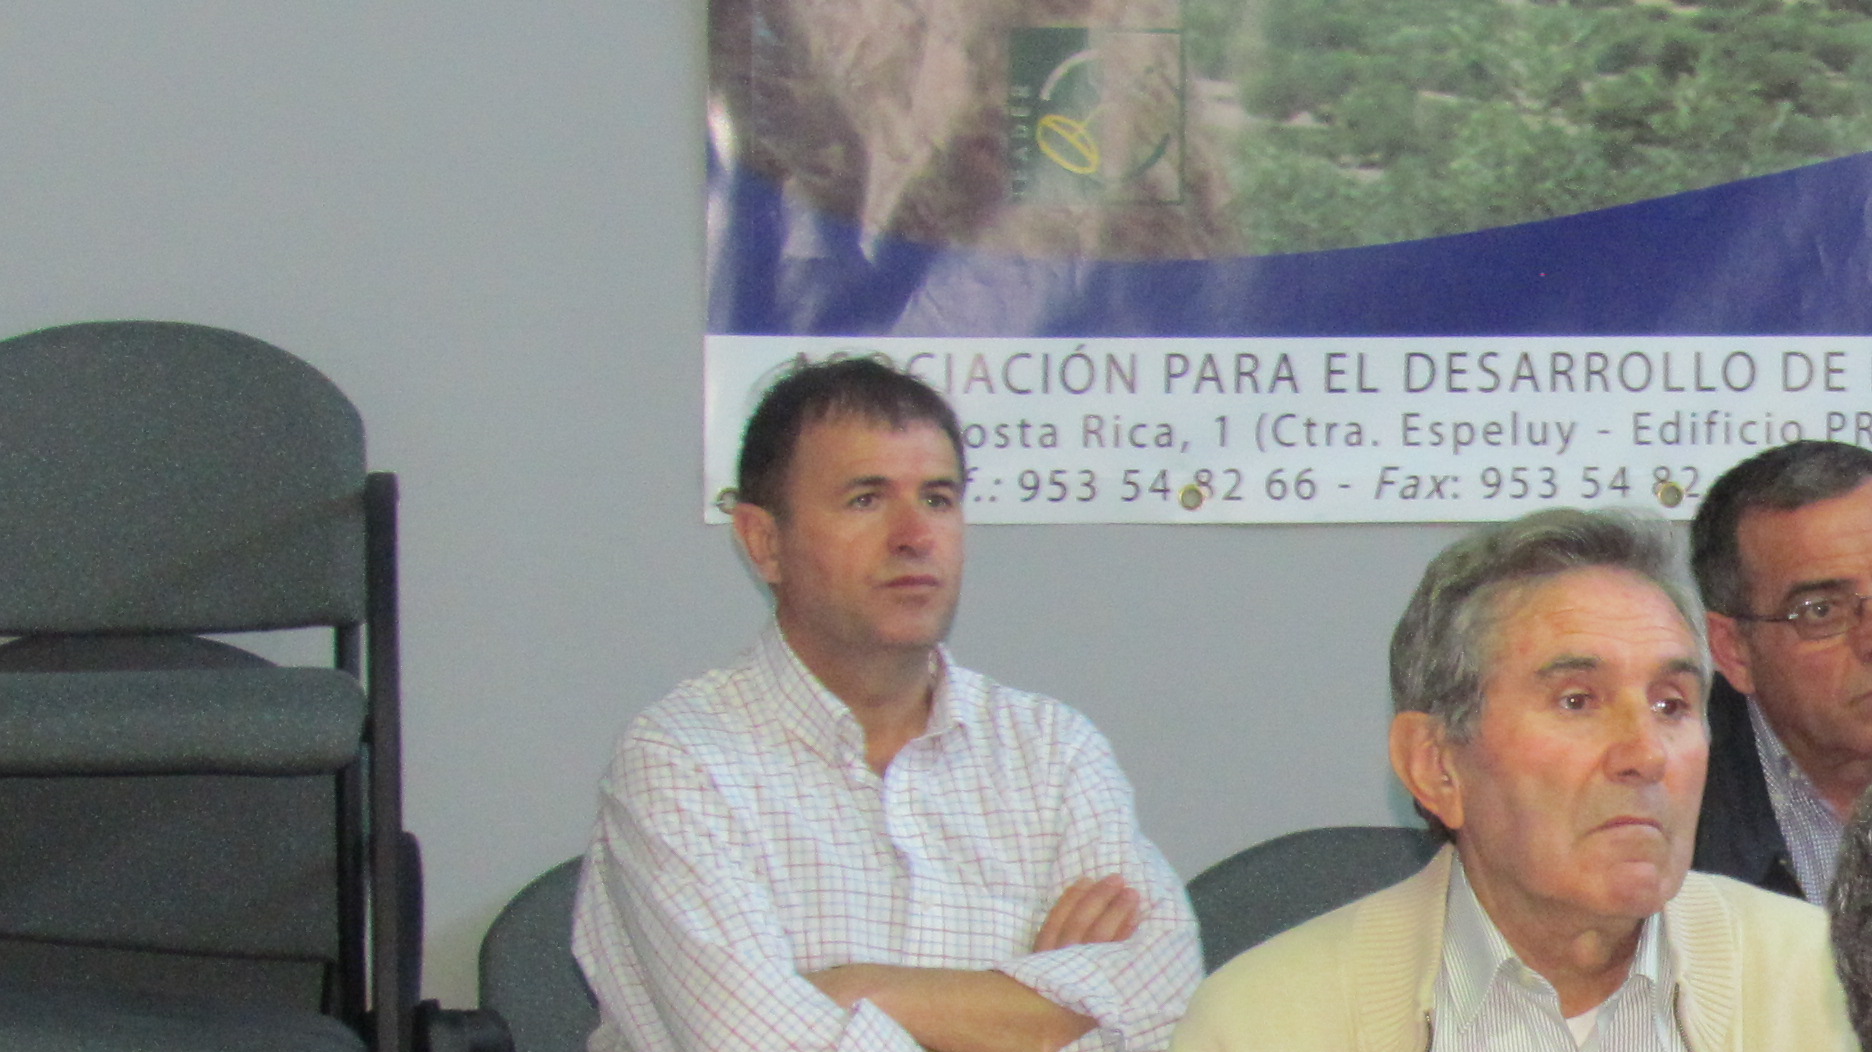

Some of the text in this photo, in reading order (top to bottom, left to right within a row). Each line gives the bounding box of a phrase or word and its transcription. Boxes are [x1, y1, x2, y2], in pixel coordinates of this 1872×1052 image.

[1163, 352, 1300, 394] PARA
[1324, 352, 1380, 393] EL
[1404, 351, 1756, 393] DESARROLLO
[1781, 351, 1848, 392] DE
[963, 418, 1058, 449] osta
[1082, 413, 1189, 453] Rica,
[1214, 415, 1230, 447] 1
[1255, 412, 1379, 452] (Ctra.
[1401, 411, 1577, 455] Espeluy
[1632, 410, 1805, 446] Edificio
[1017, 469, 1098, 502] 953
[1120, 468, 1171, 502] 54
[1193, 468, 1245, 502] 82
[1264, 467, 1317, 501] 66
[1374, 465, 1460, 501] Fax:
[1480, 466, 1558, 500] 953
[1581, 466, 1632, 500] 54
